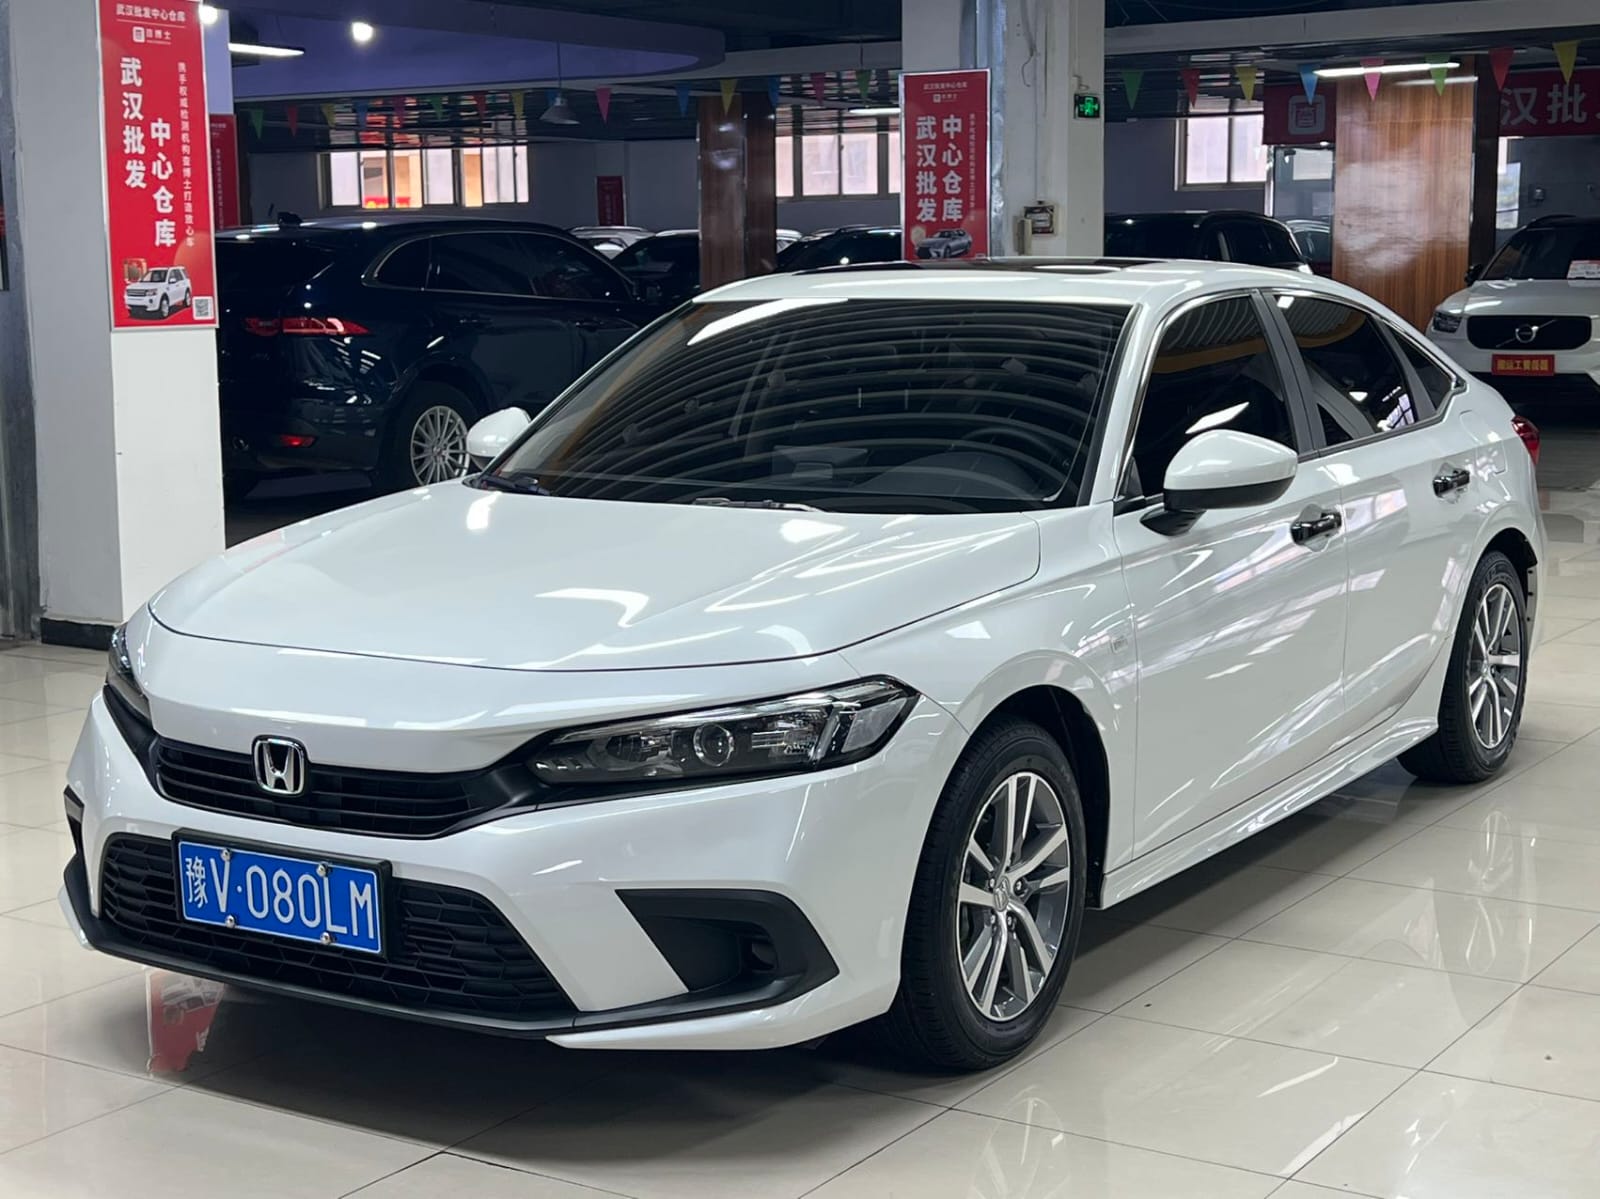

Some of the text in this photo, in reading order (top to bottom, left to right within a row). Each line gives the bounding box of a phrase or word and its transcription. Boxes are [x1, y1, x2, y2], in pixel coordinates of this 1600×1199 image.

[120, 57, 147, 189] 武汉批发
[1501, 84, 1600, 125] 汉批
[150, 118, 177, 247] 中心仓库
[916, 116, 938, 222] 武汉批发
[942, 114, 963, 222] 中心仓库
